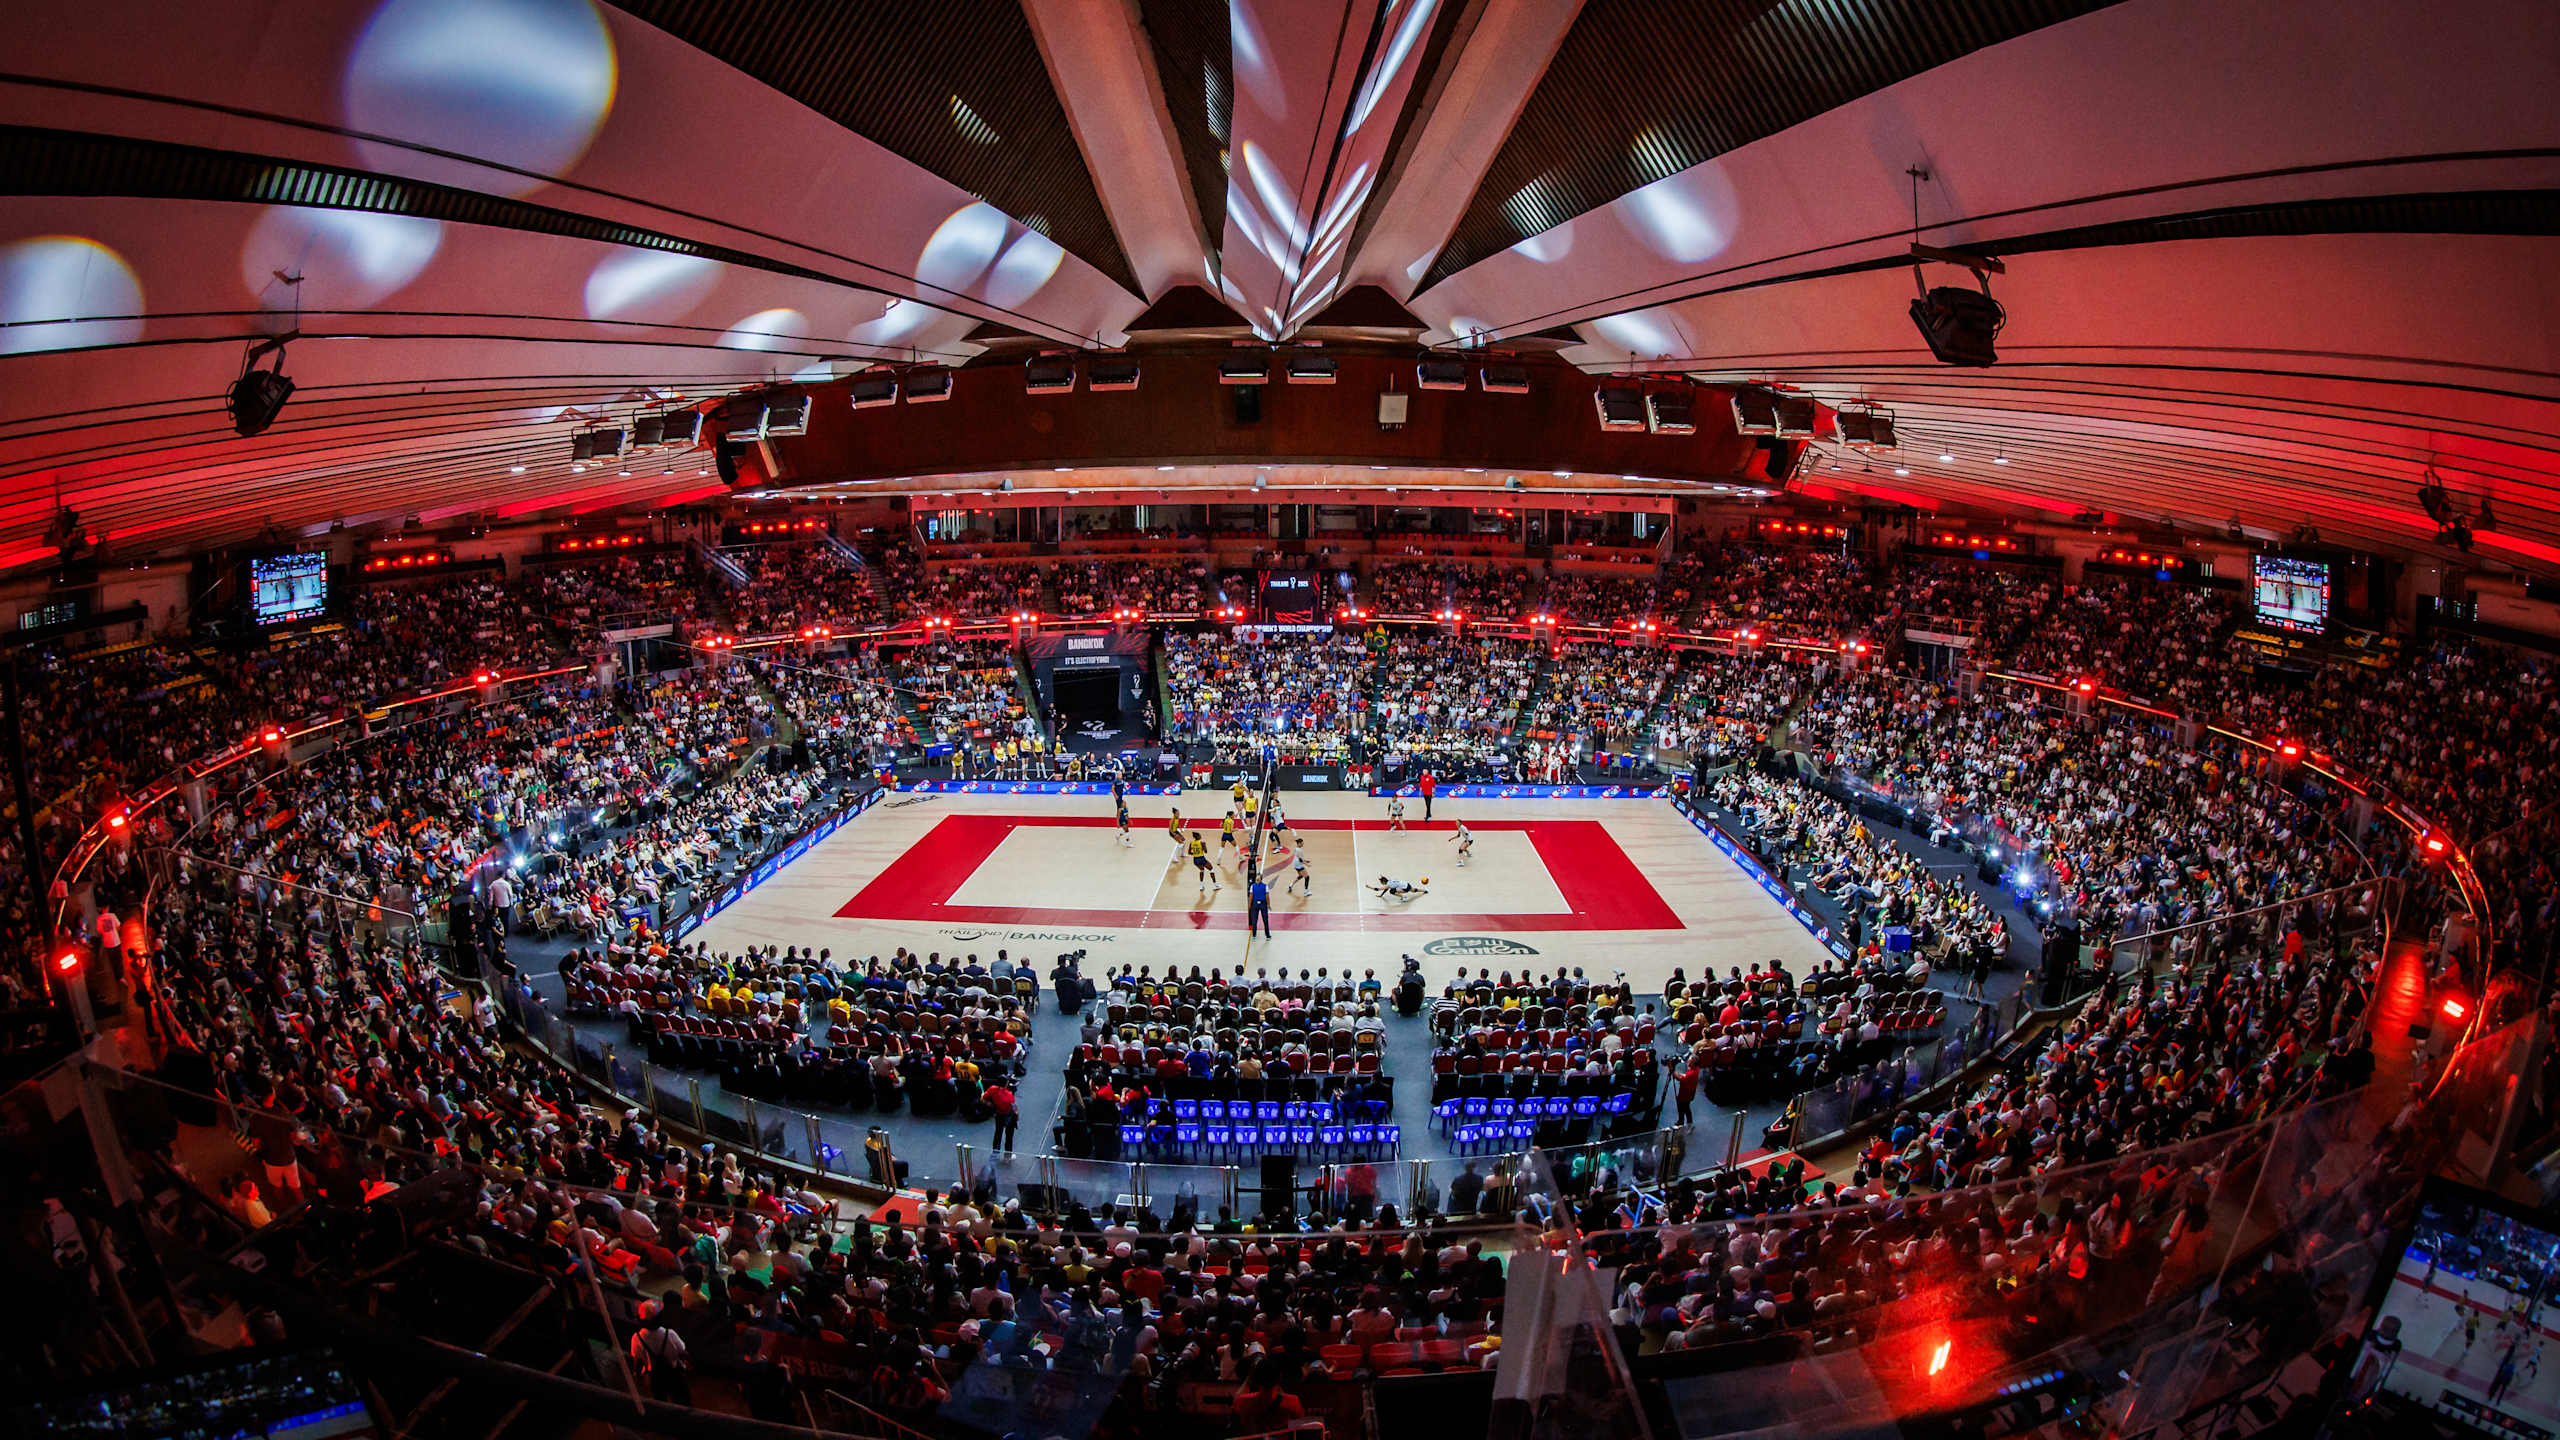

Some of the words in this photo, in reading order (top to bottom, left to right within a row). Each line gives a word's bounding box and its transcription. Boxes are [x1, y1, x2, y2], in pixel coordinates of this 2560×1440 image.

[1278, 624, 1297, 633] WORLD
[1067, 637, 1105, 650] BANGKOK
[1302, 774, 1329, 783] BANGKOK
[937, 928, 1002, 940] THAILAND
[1009, 931, 1117, 942] BANGKOK
